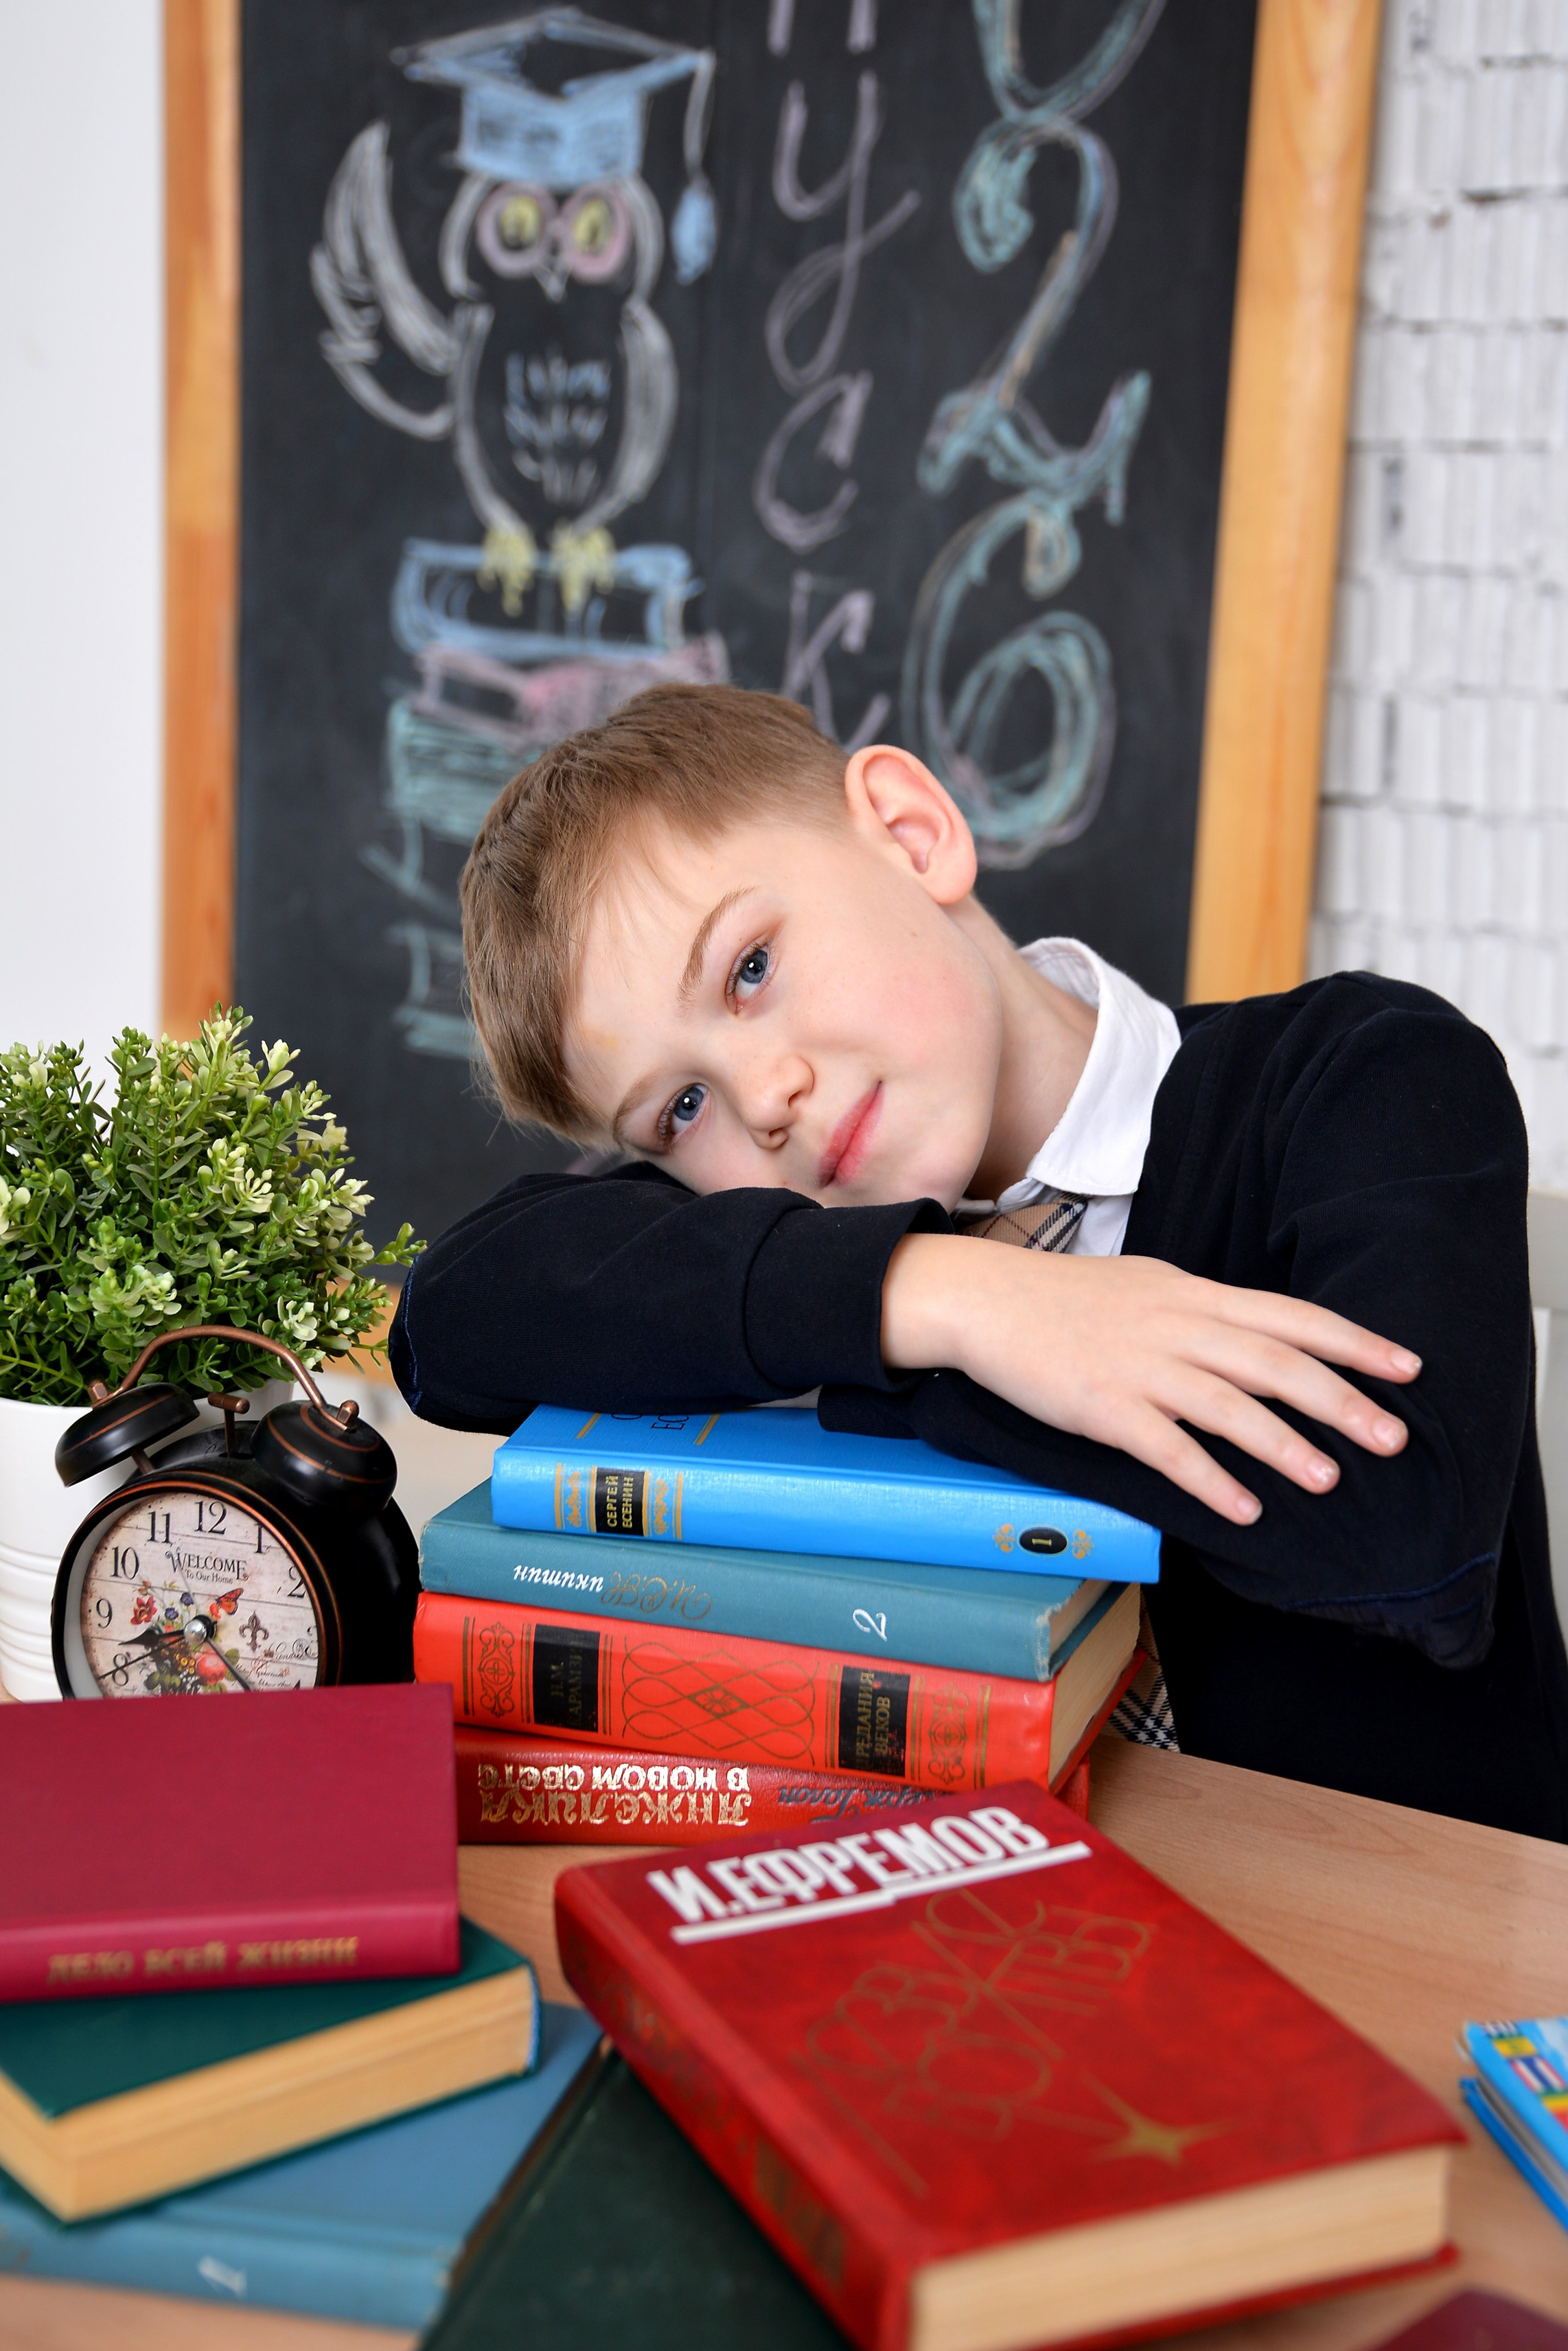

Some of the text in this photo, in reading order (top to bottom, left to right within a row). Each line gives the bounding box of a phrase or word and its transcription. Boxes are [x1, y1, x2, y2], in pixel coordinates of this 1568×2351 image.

[195, 1500, 227, 1535] 12
[607, 1474, 619, 1528] СЕРГЕЙ
[622, 1476, 634, 1528] ЕСЕНИН
[147, 1511, 172, 1544] 11
[254, 1523, 266, 1554] 1
[111, 1546, 139, 1579] 10
[165, 1549, 249, 1581] WELCOME
[196, 1571, 210, 1582] Our
[211, 1573, 233, 1584] Home
[96, 1598, 113, 1629] 9
[852, 1608, 887, 1642] 2
[112, 1653, 130, 1686] 8
[875, 1696, 891, 1755] ВЕКОВ
[479, 1763, 750, 1792] В НОВОМ СВЕТЕ
[480, 1789, 752, 1826] АНЖЕЛИКА
